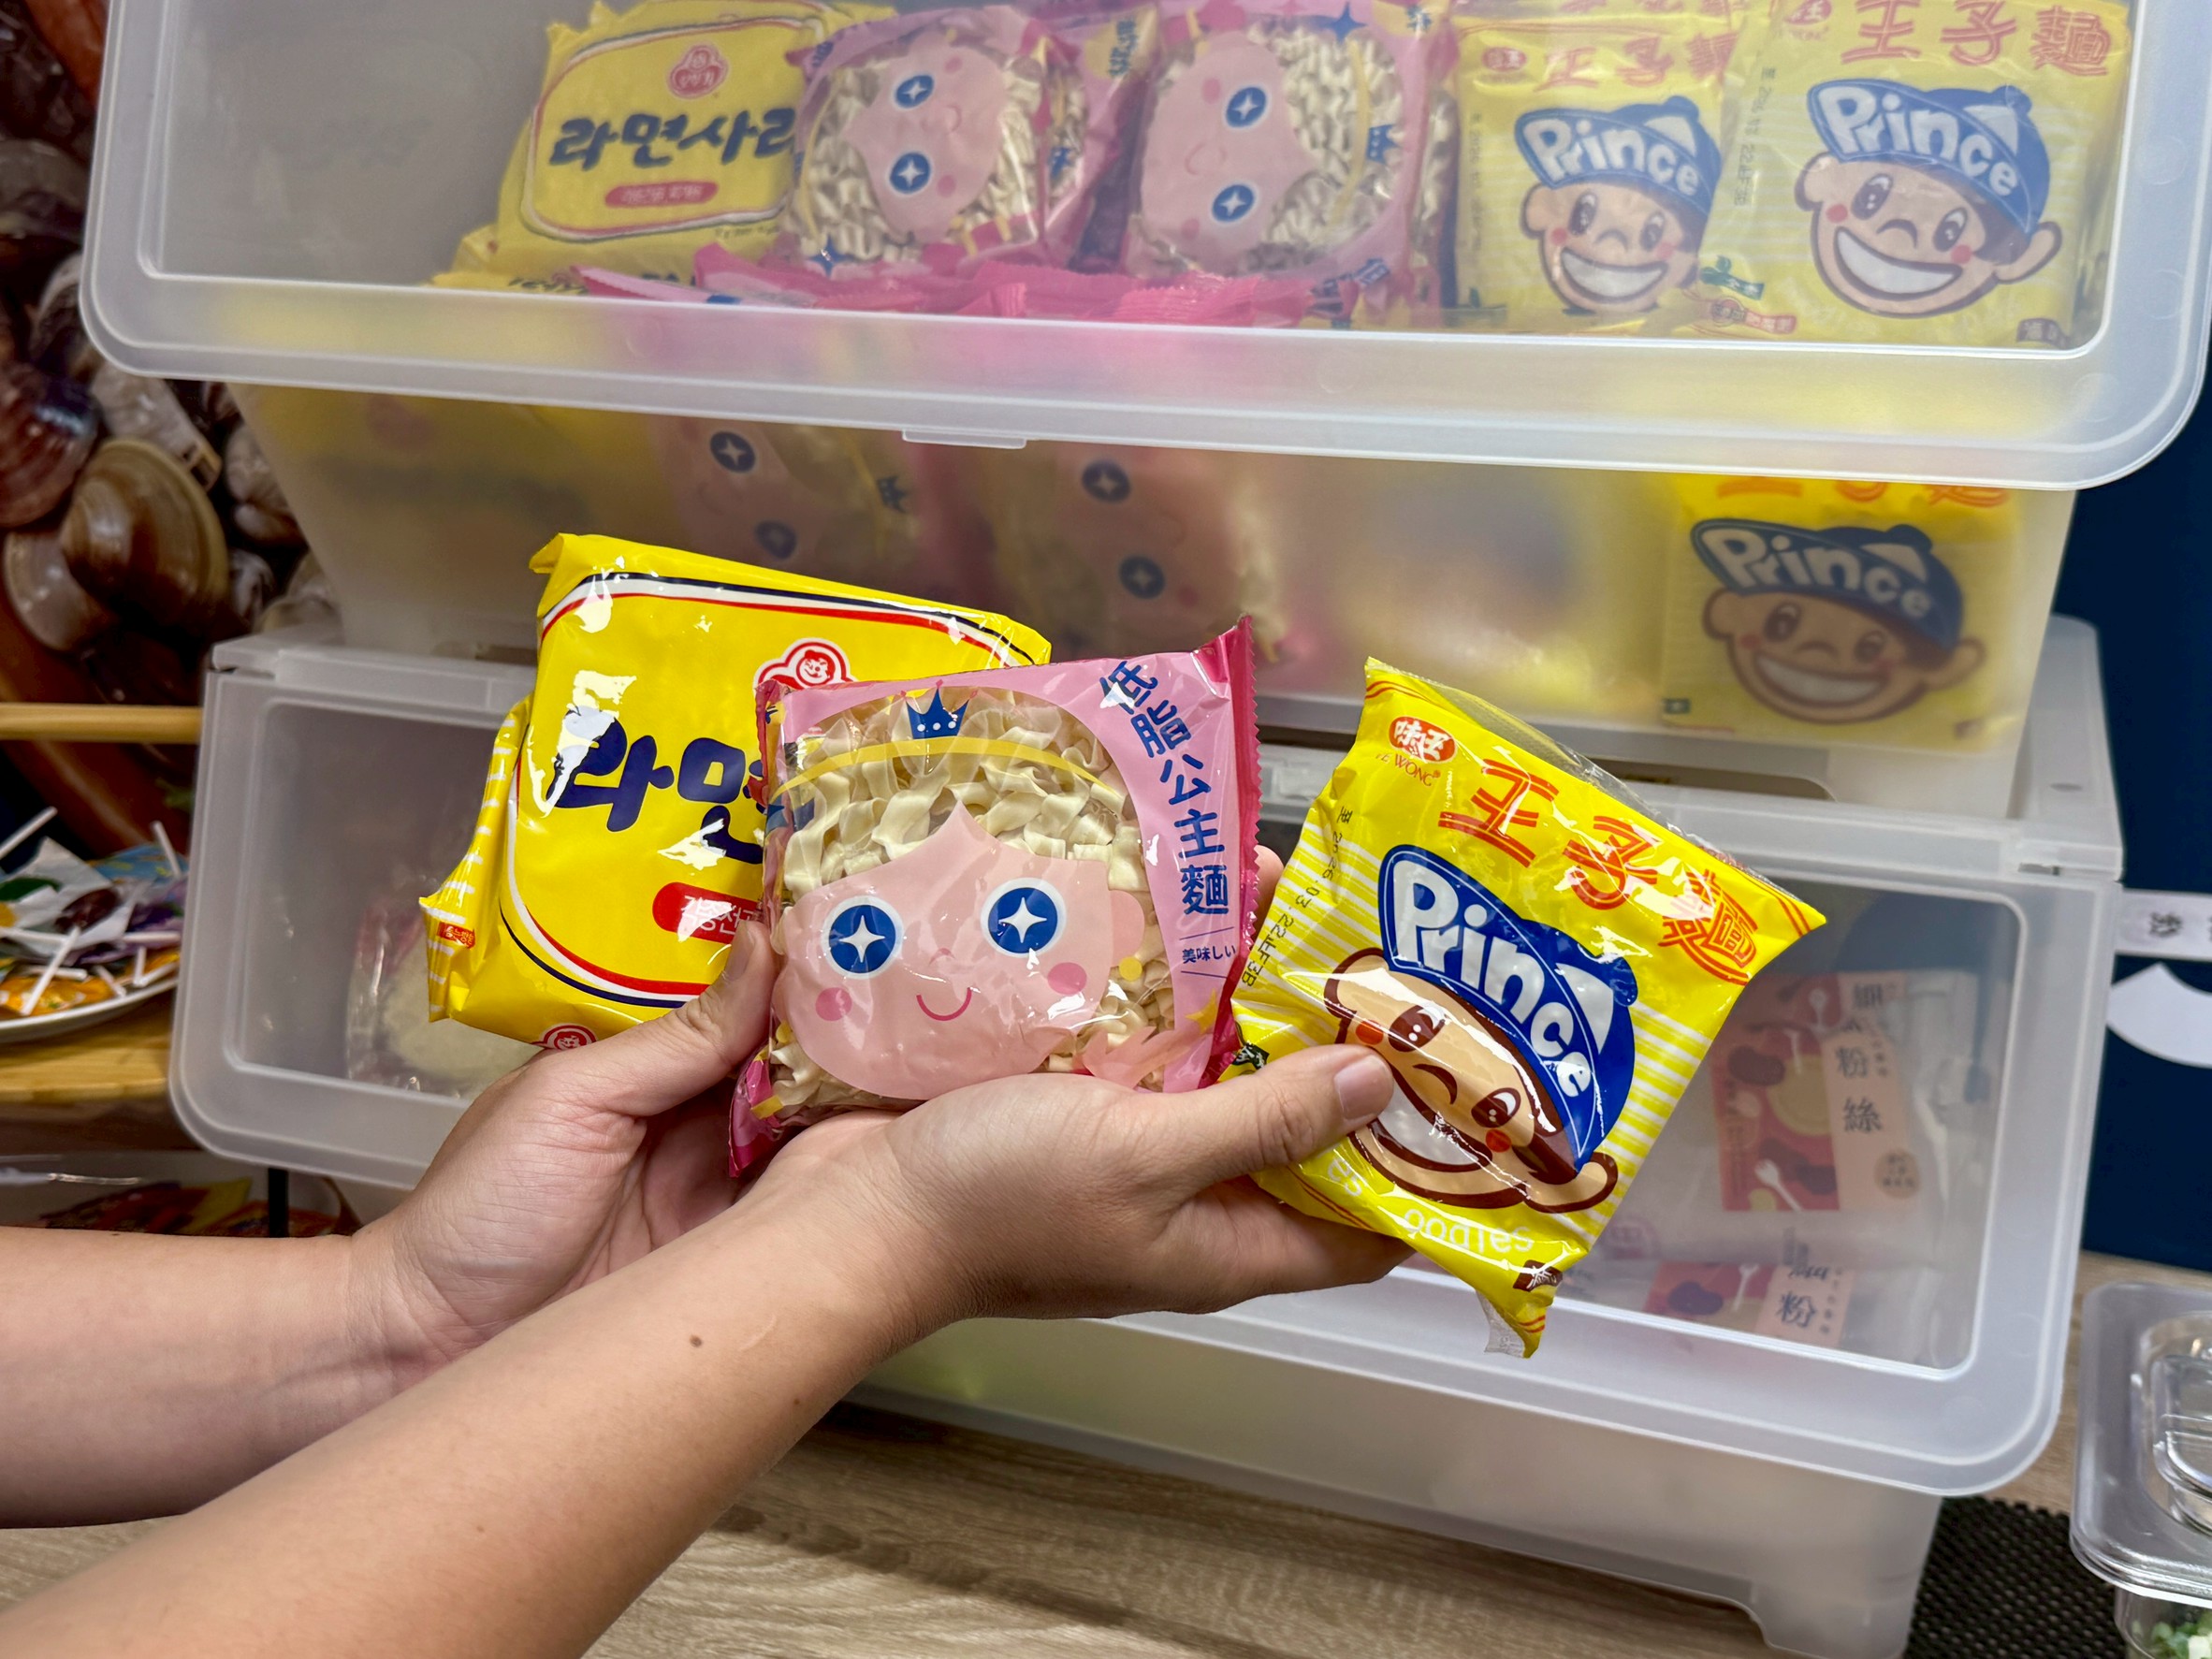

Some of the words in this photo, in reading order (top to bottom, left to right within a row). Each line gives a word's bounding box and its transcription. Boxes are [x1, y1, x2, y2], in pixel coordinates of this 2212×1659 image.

[1841, 0, 2111, 76] 王子麵
[1523, 118, 1698, 196] Prince
[1818, 86, 2016, 196] Prince
[1701, 528, 1931, 618] Prince
[1099, 660, 1230, 915] 低脂公主麵
[1438, 759, 1759, 987] 王子麵
[1182, 945, 1236, 965] 美味しい
[1393, 860, 1591, 1097] Prince
